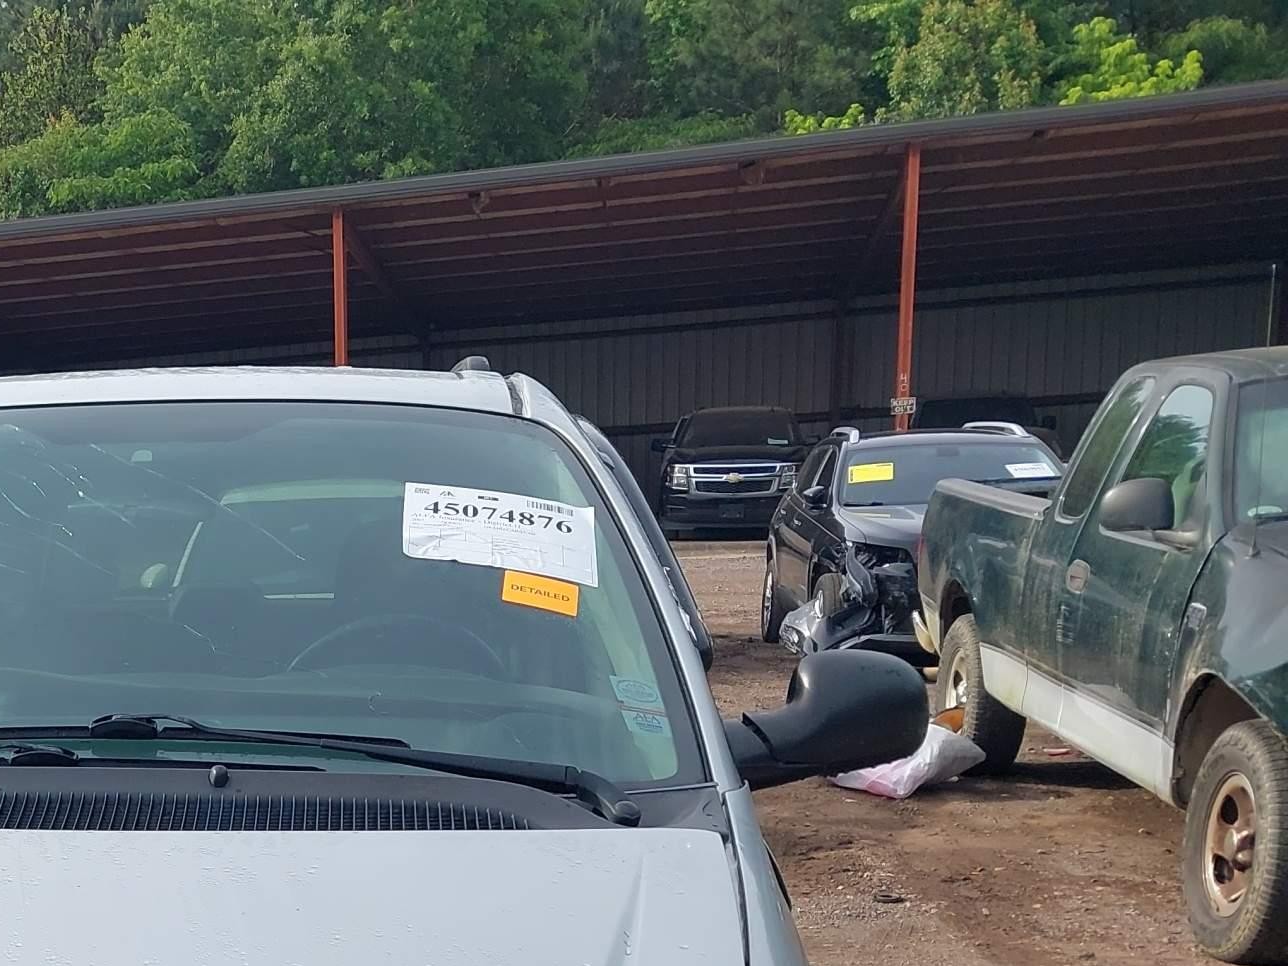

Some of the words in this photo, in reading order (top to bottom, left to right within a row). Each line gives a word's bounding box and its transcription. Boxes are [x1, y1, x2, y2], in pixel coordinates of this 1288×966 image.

[894, 405, 914, 413] OUT
[424, 500, 573, 534] 45074876
[511, 583, 570, 602] DETAILED
